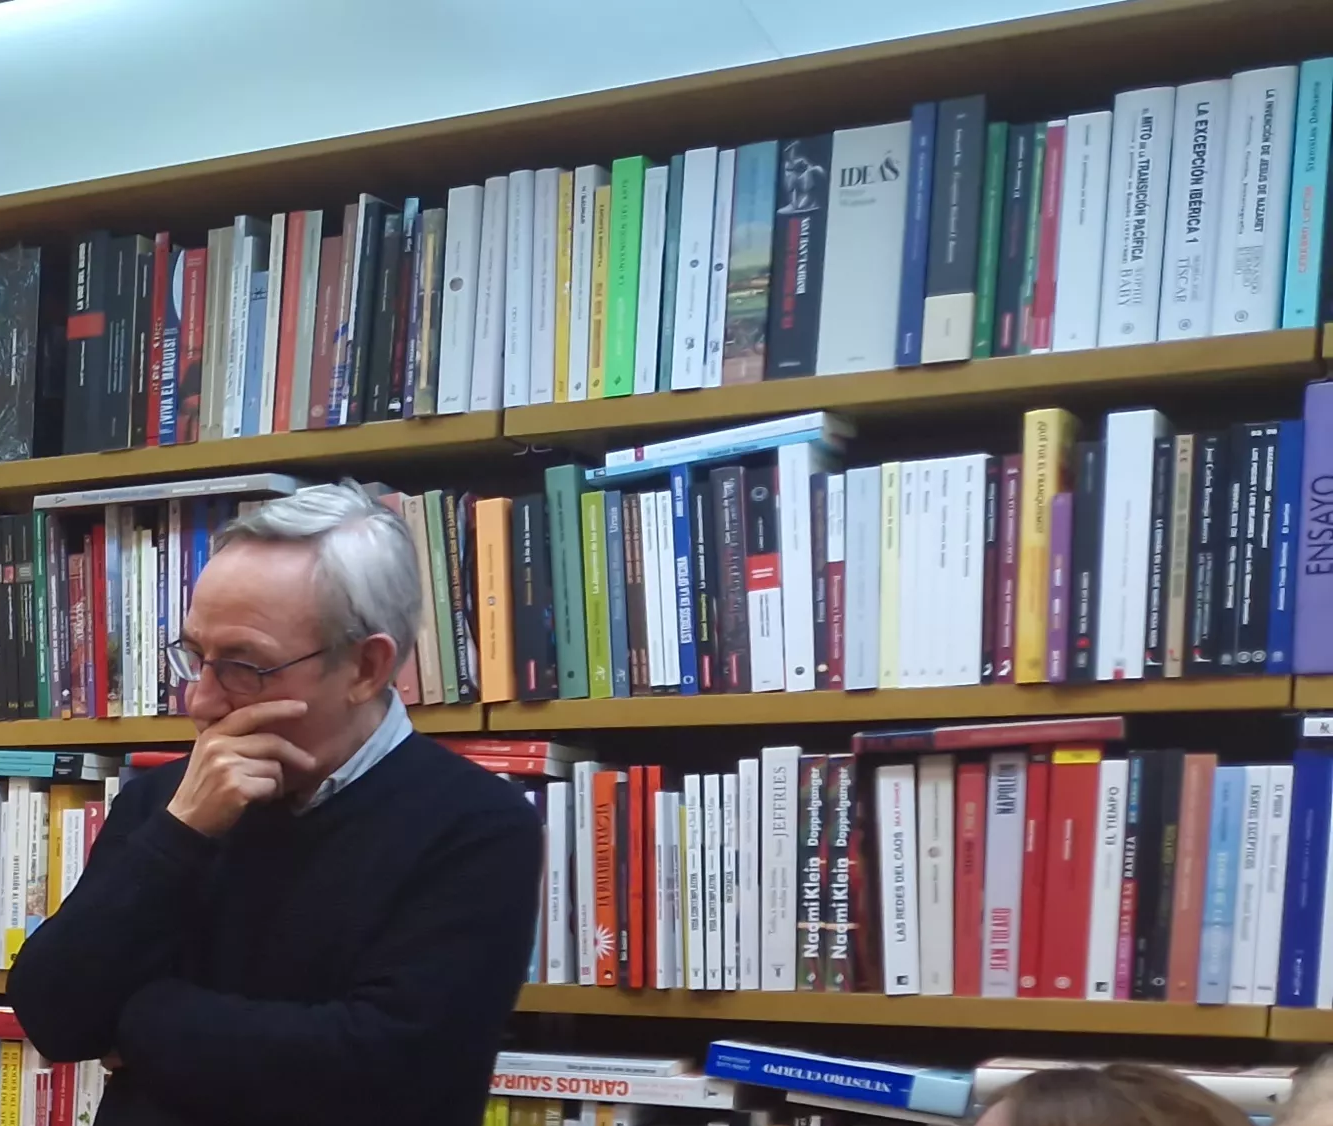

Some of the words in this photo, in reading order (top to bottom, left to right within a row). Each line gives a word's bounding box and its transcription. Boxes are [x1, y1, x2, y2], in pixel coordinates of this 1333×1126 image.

[1140, 116, 1153, 141] MITO
[1196, 102, 1210, 117] LA
[1261, 100, 1275, 144] INVENCIÓN
[1190, 119, 1208, 186] EXCEPCIÓN
[1134, 159, 1151, 217] TRANSICIÓN
[1186, 188, 1203, 234] IBÉRICA
[1130, 219, 1148, 262] PACÍFICA
[1117, 268, 1132, 307] BABY
[1305, 475, 1333, 577] ENSAYO
[771, 765, 789, 838] JEFFRIES
[806, 767, 822, 847] Doppelganger
[835, 767, 851, 847] Doppelganger
[1106, 787, 1119, 830] TIEMPO
[893, 832, 904, 860] CAOS
[1106, 835, 1116, 846] EL
[802, 857, 821, 899] Klein
[831, 857, 850, 900] Klein
[894, 865, 904, 883] DEL
[895, 885, 906, 920] REDES
[802, 901, 820, 958] Naomi
[831, 902, 849, 960] Naomi
[896, 922, 907, 942] LAS
[990, 908, 1013, 945] TULARD
[991, 948, 1010, 972] JEAN
[490, 1073, 552, 1095] SAURA
[555, 1076, 630, 1097] CARLOS
[762, 1063, 823, 1084] CUERPO
[824, 1072, 893, 1095] NUESTRO
